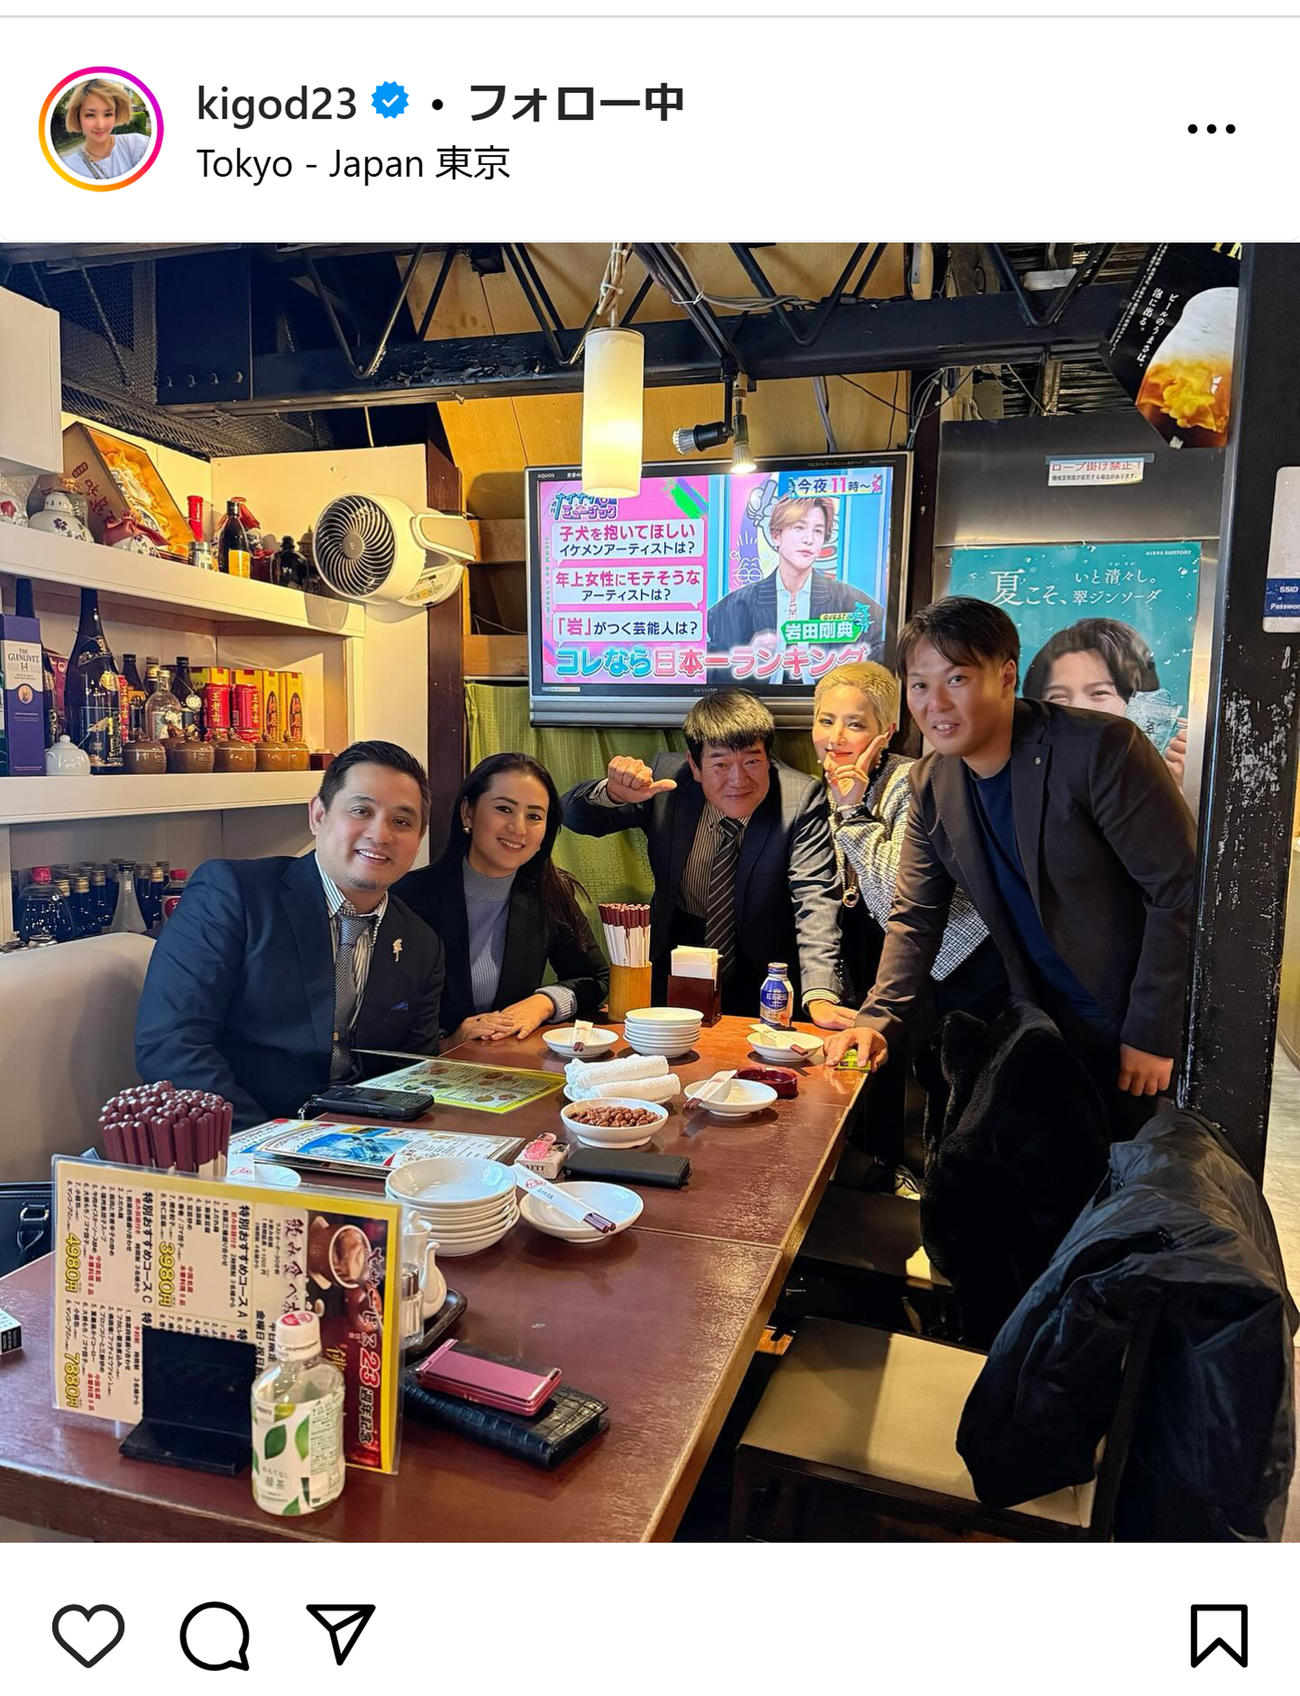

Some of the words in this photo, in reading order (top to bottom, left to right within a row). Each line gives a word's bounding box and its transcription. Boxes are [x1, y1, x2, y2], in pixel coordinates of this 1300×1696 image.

[559, 523, 696, 542] 子犬を抱いてほしい
[555, 570, 701, 588] 年上女性にモテそうな
[989, 568, 1067, 606] 夏こそ、
[1072, 589, 1162, 606] 翠ジンソーダ
[1279, 585, 1299, 593] SSID
[785, 622, 854, 641] 岩田剛典
[8, 652, 40, 664] GLENLIVET
[142, 1191, 154, 1292] 特別おすすめコース
[65, 1232, 81, 1293] 4980円
[238, 1205, 251, 1307] 特別おすすめコース
[159, 1241, 176, 1308] 3980円
[142, 1295, 153, 1304] C
[237, 1310, 248, 1318] A
[64, 1352, 81, 1409] 7880円
